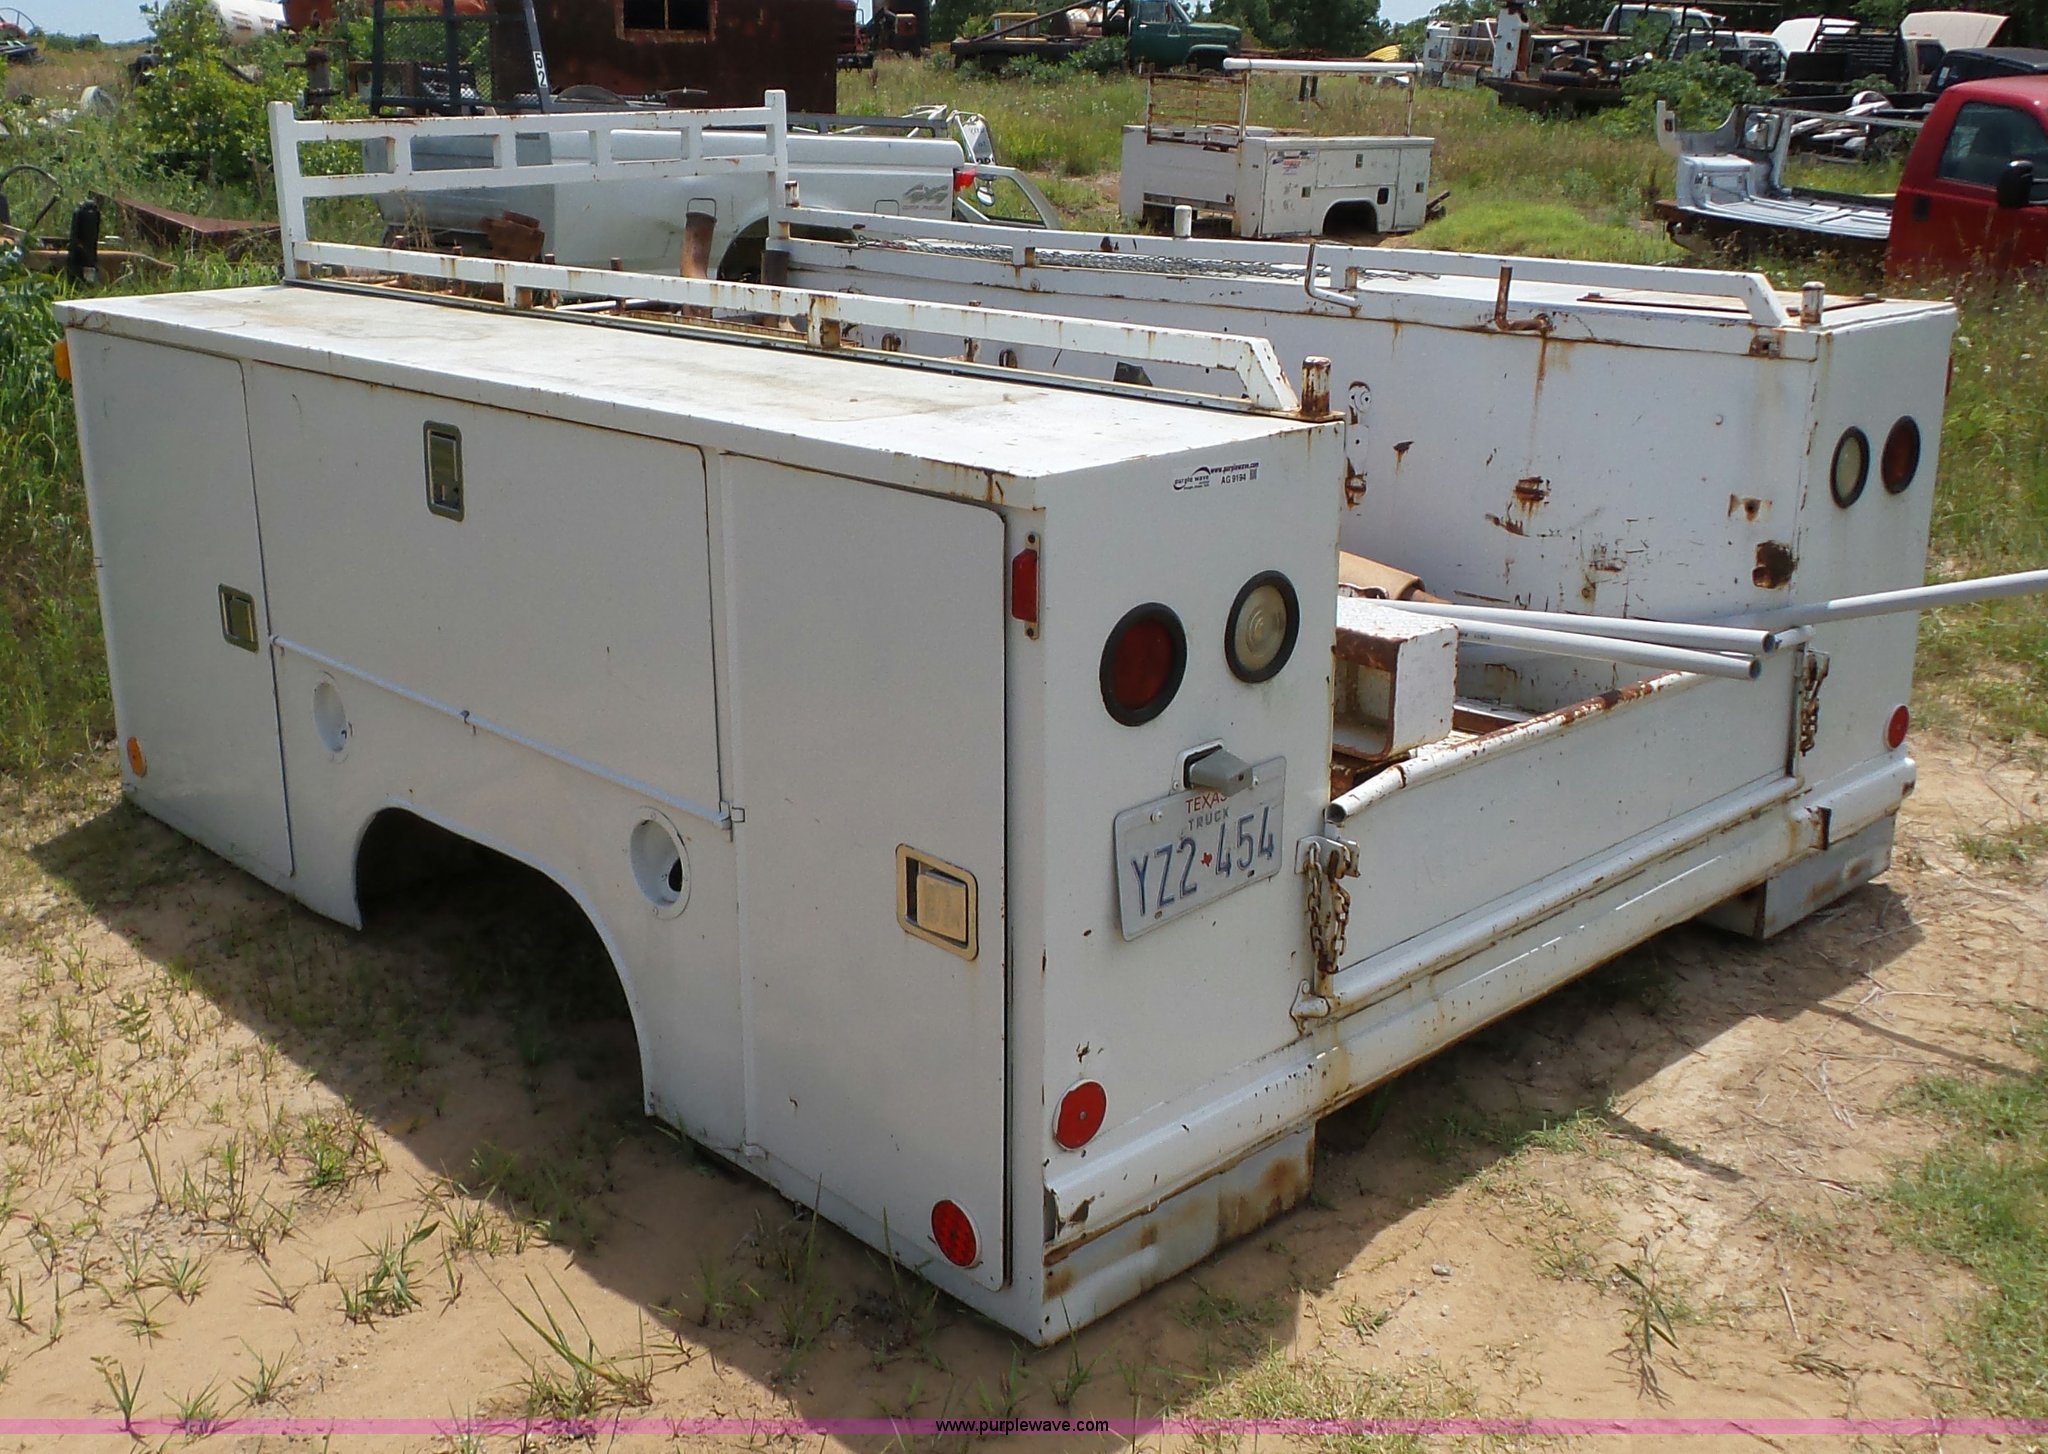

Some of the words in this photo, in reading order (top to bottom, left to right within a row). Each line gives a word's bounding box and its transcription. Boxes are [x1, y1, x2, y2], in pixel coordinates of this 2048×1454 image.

[534, 52, 547, 87] 52
[1174, 476, 1193, 486] purple
[1221, 475, 1231, 484] AG
[1188, 807, 1230, 831] TRUCK
[1130, 836, 1198, 917] YZ2
[1215, 805, 1275, 878] 454
